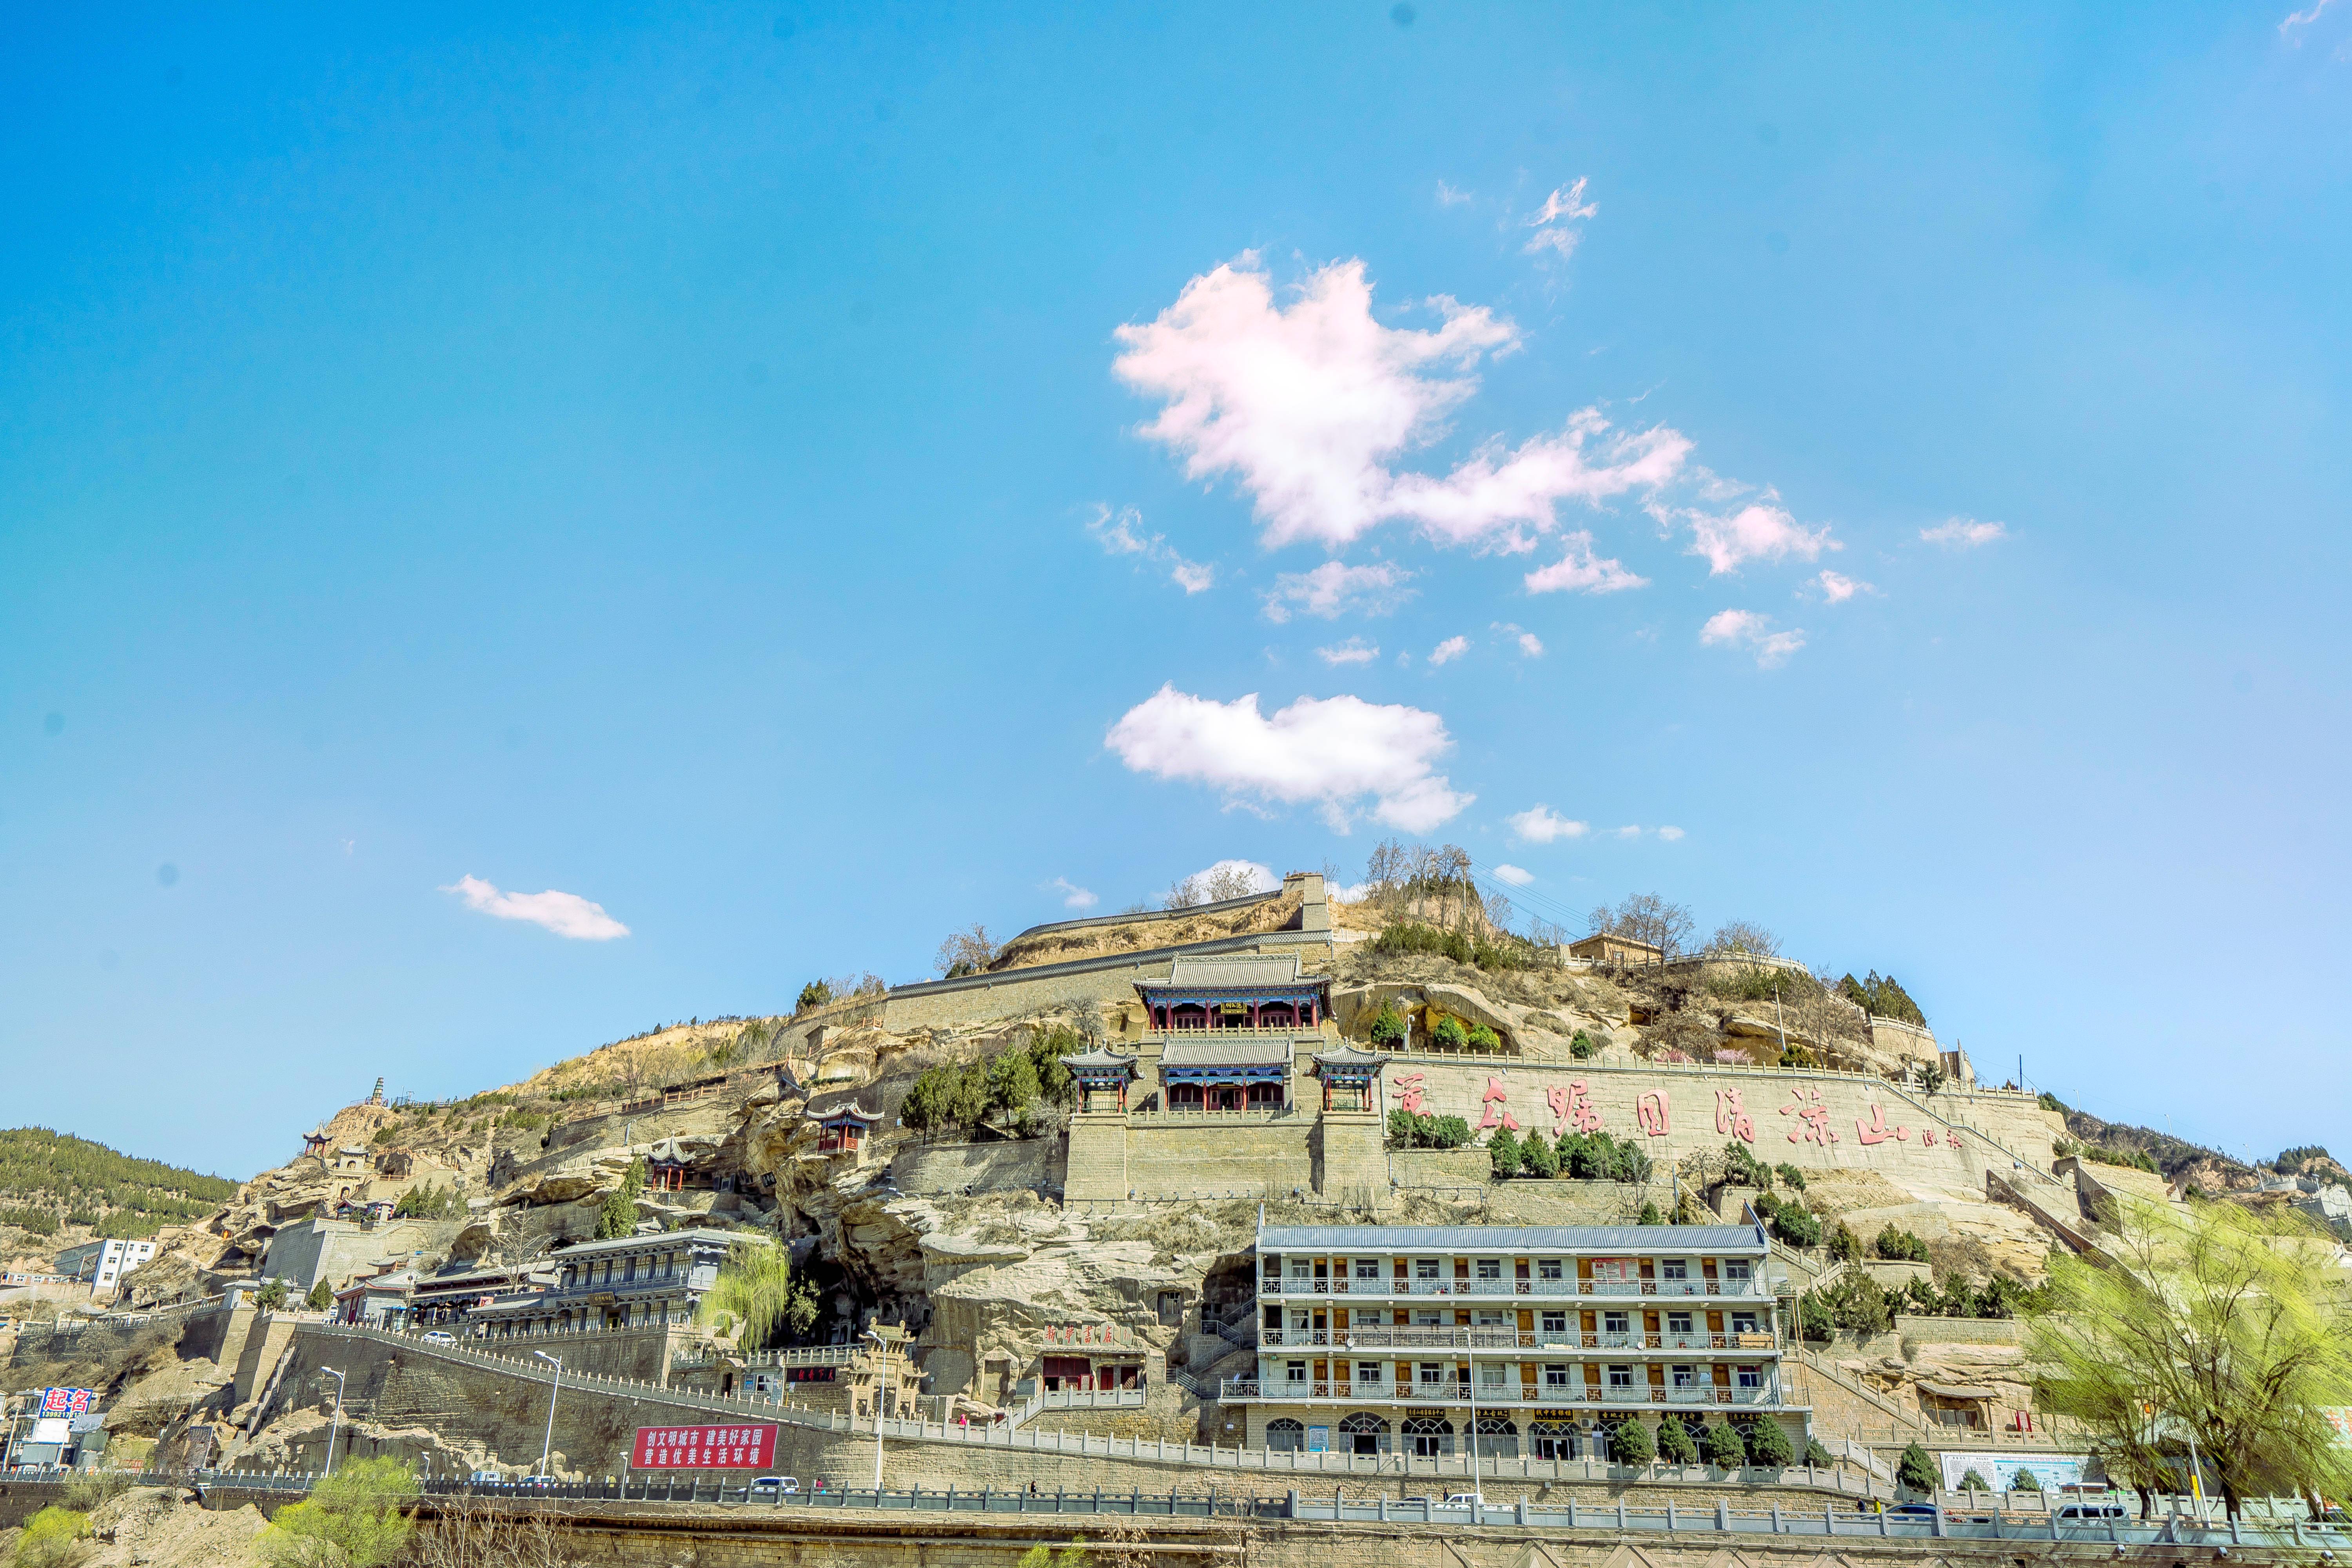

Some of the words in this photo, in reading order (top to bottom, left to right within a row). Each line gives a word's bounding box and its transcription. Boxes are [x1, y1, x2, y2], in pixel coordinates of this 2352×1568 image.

[43, 1388, 91, 1412] 起名
[647, 1429, 699, 1447] 创文明城市
[706, 1429, 763, 1446] 建美好家园
[645, 1447, 760, 1465] 营造优美生活环境
